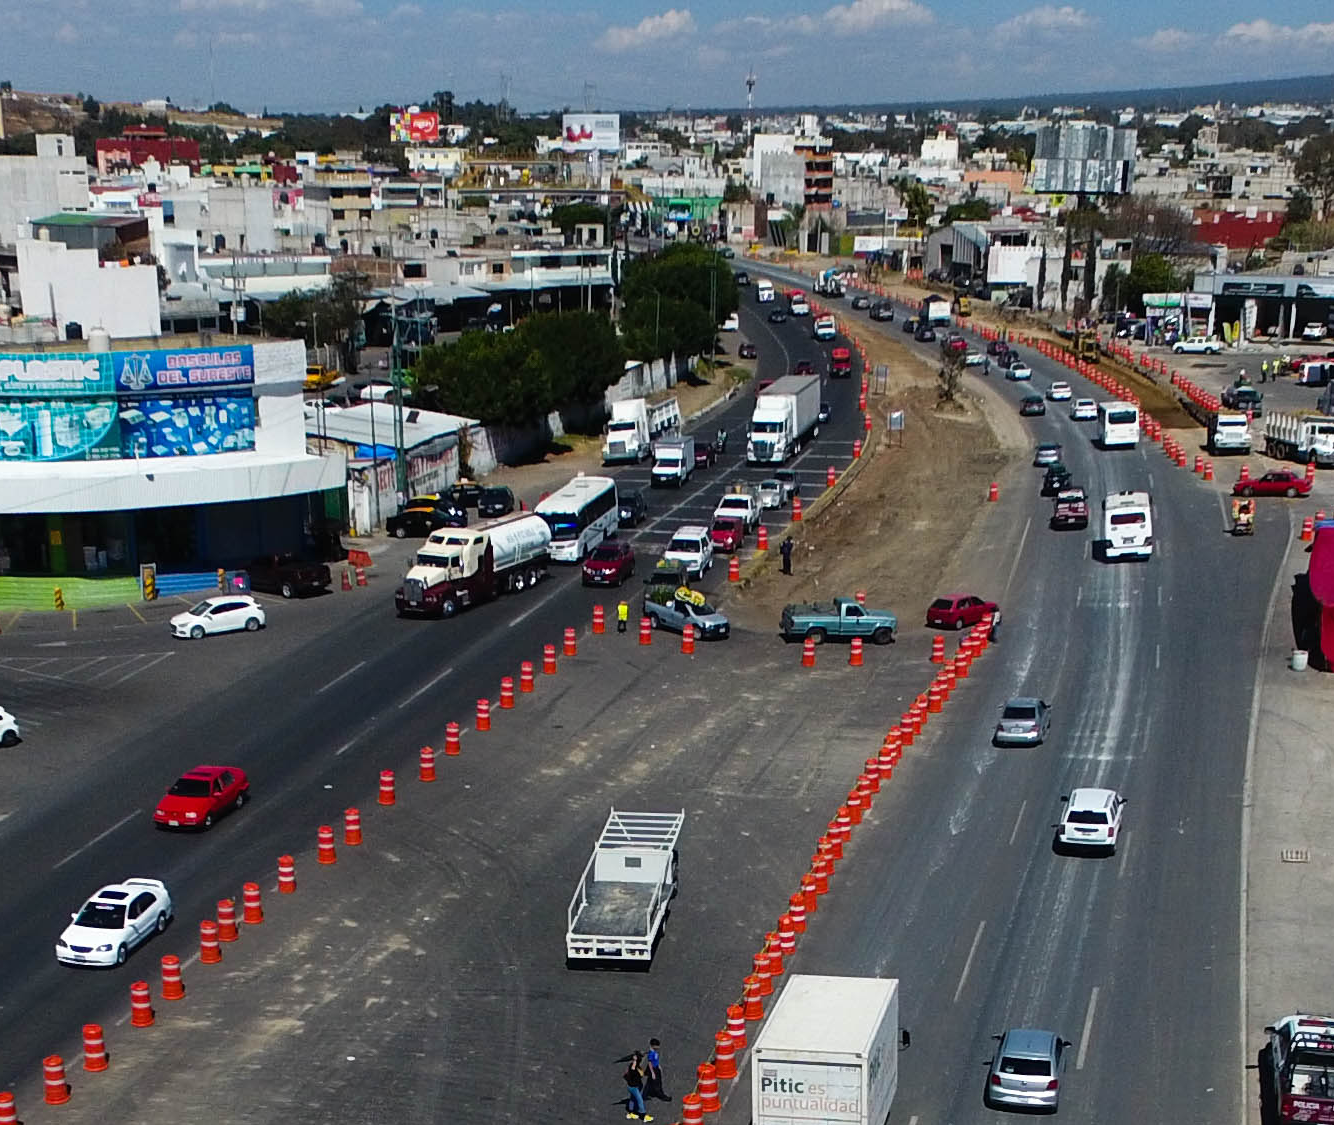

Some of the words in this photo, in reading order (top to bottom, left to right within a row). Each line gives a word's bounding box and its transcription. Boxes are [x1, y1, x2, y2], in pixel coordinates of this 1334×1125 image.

[166, 351, 242, 368] BASCULAS
[157, 370, 187, 385] DEL
[189, 365, 252, 384] SURESTE
[761, 1077, 804, 1094] Pitic
[808, 1084, 826, 1095] es
[762, 1096, 859, 1114] puntualidad
